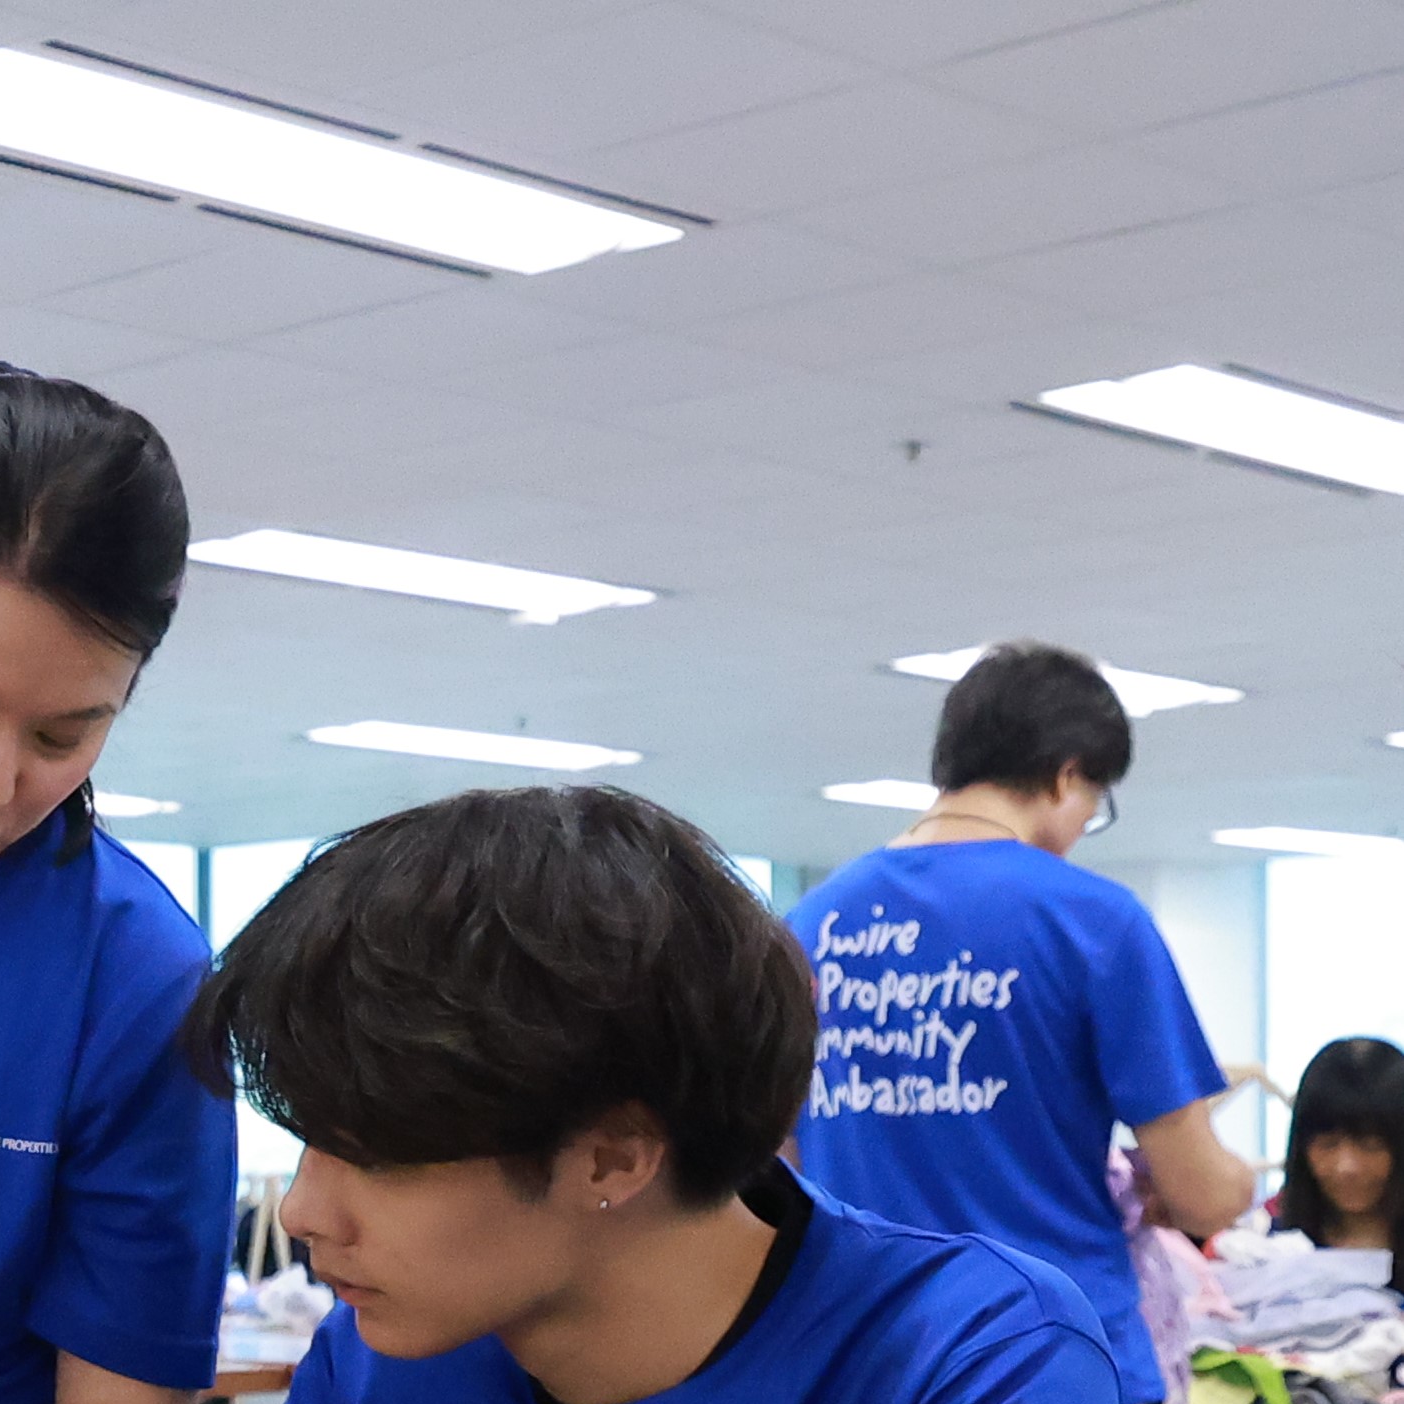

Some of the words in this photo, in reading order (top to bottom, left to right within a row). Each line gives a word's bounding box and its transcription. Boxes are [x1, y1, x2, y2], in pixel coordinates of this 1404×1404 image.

[814, 902, 922, 962] Swire
[818, 949, 1021, 1027] Properties
[809, 1064, 1008, 1119] Ambassador
